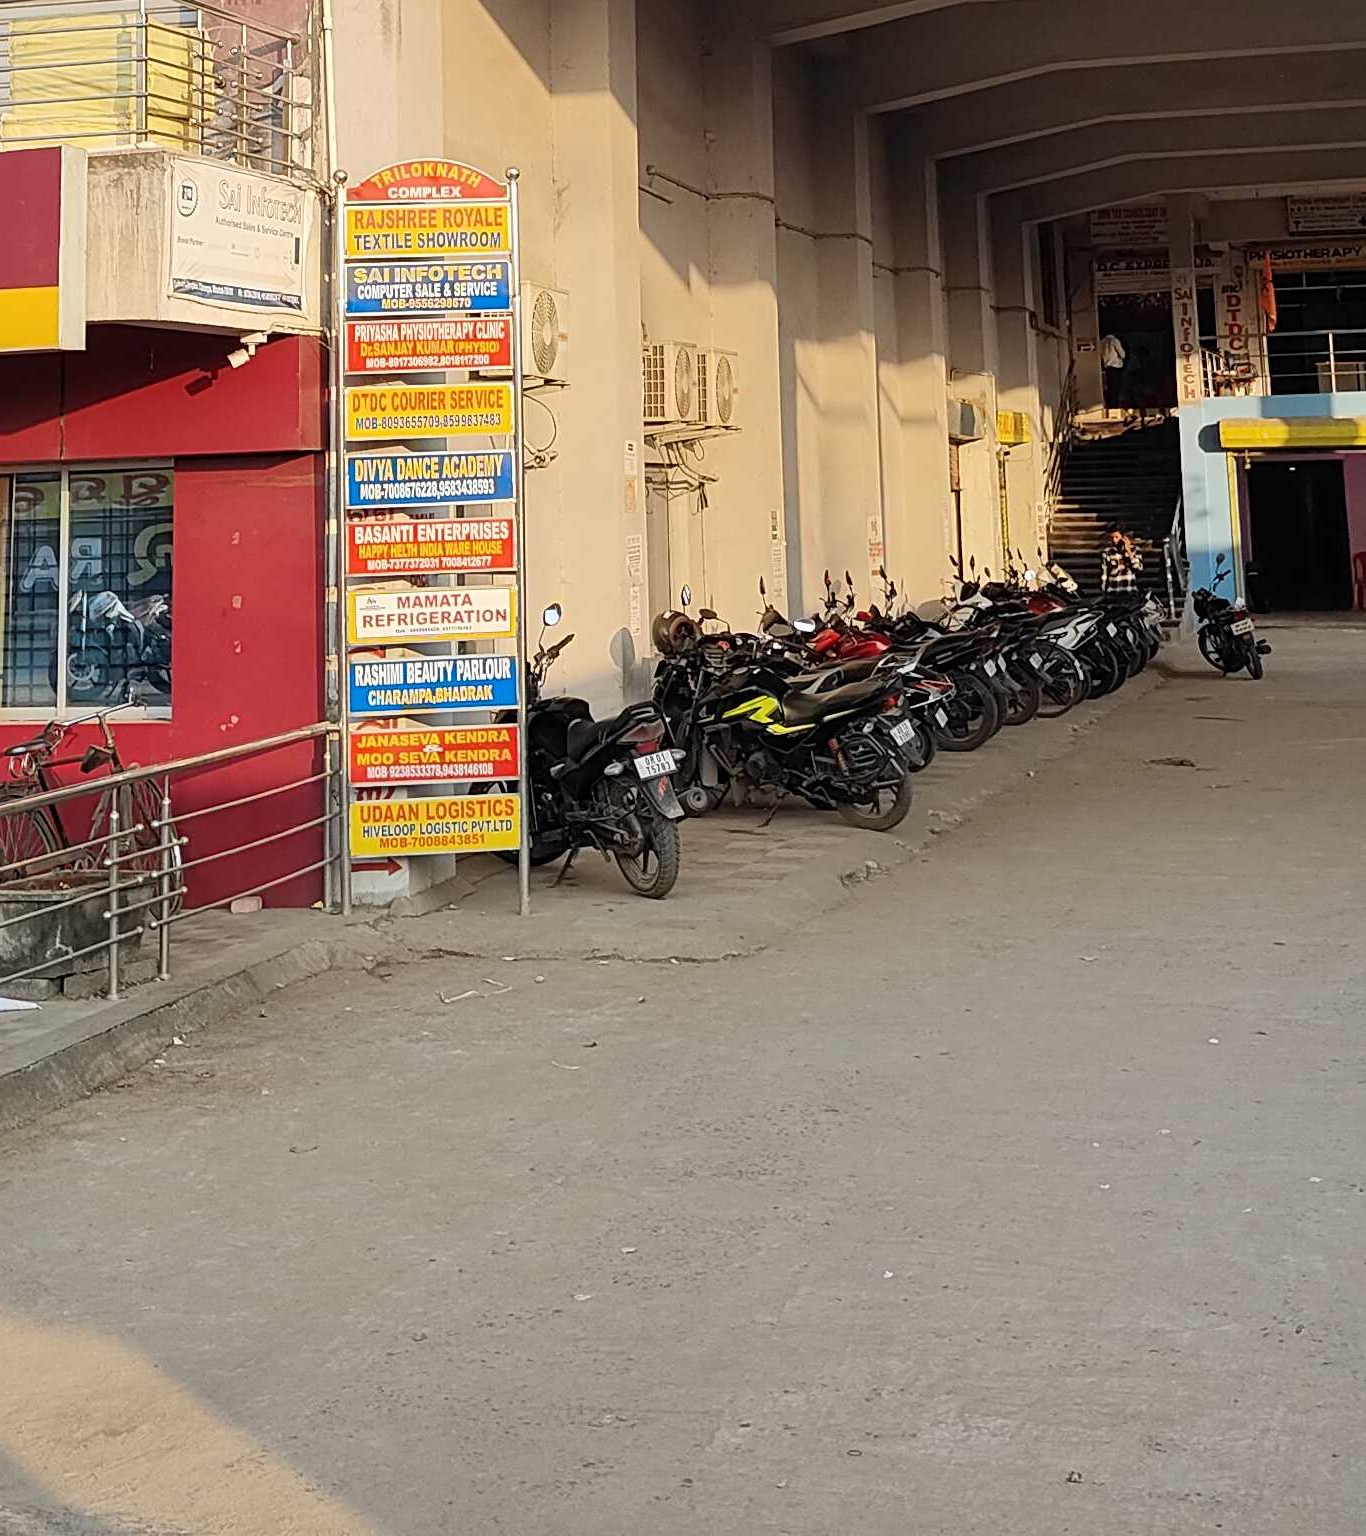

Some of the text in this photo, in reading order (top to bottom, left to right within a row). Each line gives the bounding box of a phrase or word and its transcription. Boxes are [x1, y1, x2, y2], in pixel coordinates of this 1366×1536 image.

[371, 162, 482, 189] TRILOKNATH
[387, 186, 462, 199] COMPLEX
[354, 207, 503, 230] RAJSHREE ROYALE
[354, 232, 501, 250] TEXTILE SHOWROOM
[353, 264, 502, 283] SAI INFOTECH
[358, 282, 497, 299] COMPUTER SALE & SERVICE
[355, 321, 505, 342] PRIYASHA PHYSIOTHERAPY CLINIC
[416, 341, 455, 355] KUMAR
[353, 390, 503, 413] DTDC COURIER SERVICE
[355, 455, 503, 482] DIVYA DANCE ACADEMY
[355, 522, 509, 544] BASANTI ENTERPRISES
[359, 541, 502, 559] HAPPY INDIA HOUSE
[397, 593, 473, 609] MAMATA
[363, 609, 507, 628] REFRIGERATION
[355, 658, 511, 686] RASHIMI BEAUTY PARLOUR
[357, 730, 510, 748] JANASEVA KENDRA
[399, 749, 512, 763] SEVA KENDRA
[360, 799, 515, 823] UDAAN LOGISTICS
[363, 821, 468, 838] HIVELOOP LOGISTIC
